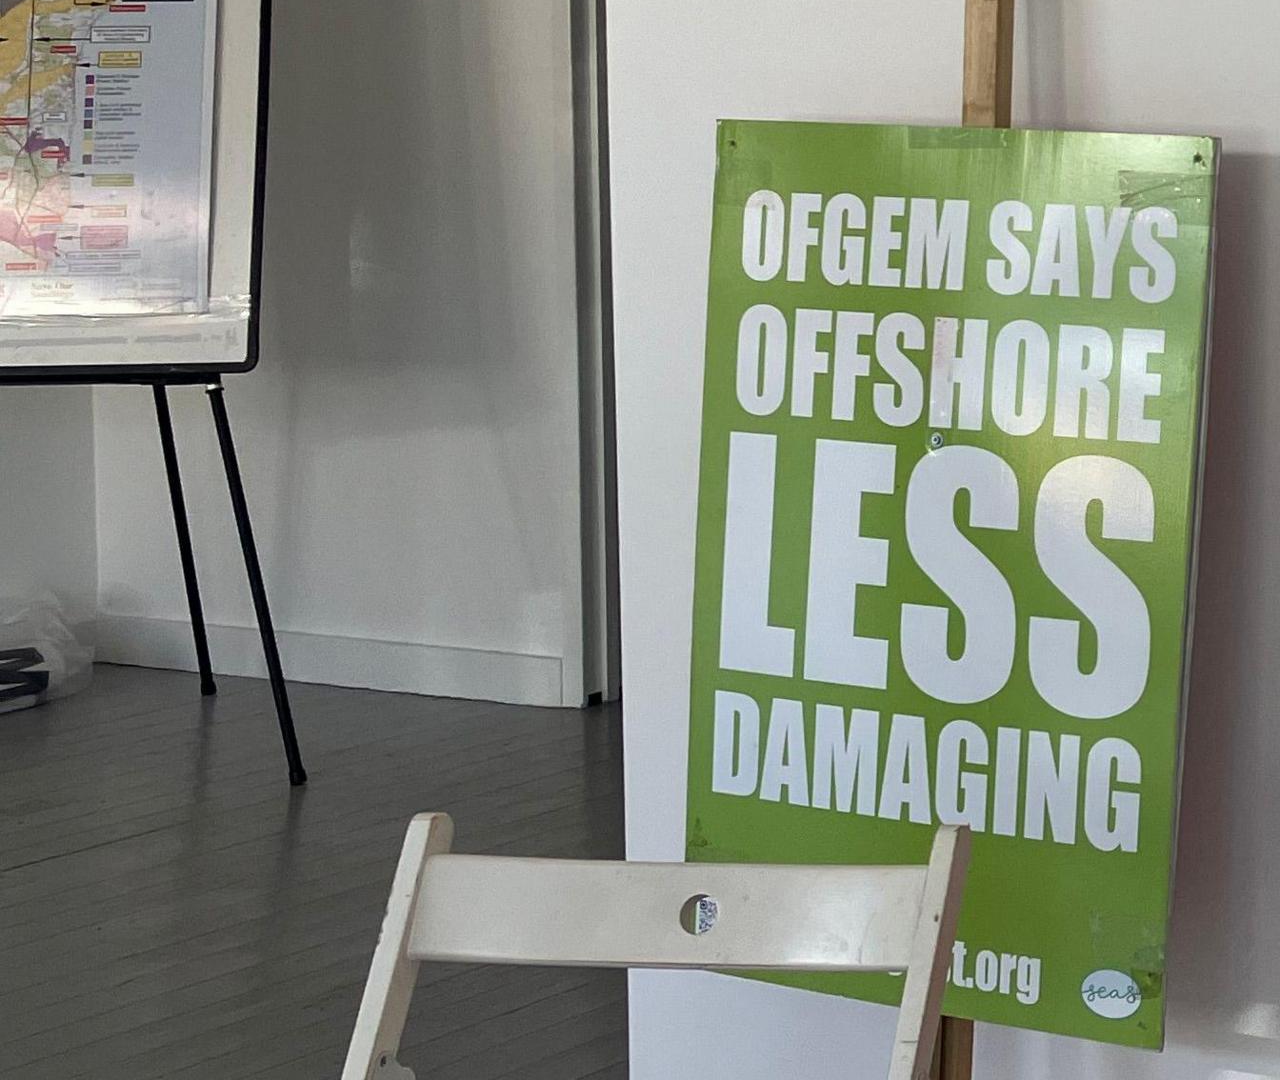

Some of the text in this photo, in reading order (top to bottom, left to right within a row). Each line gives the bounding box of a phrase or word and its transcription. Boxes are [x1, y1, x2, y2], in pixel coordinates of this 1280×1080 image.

[741, 189, 1178, 304] OFGEM SAYS
[735, 304, 1166, 444] OFFSHORE
[719, 431, 1155, 719] LESS
[711, 689, 1143, 853] DAMAGING
[1084, 983, 1139, 1003] seas
